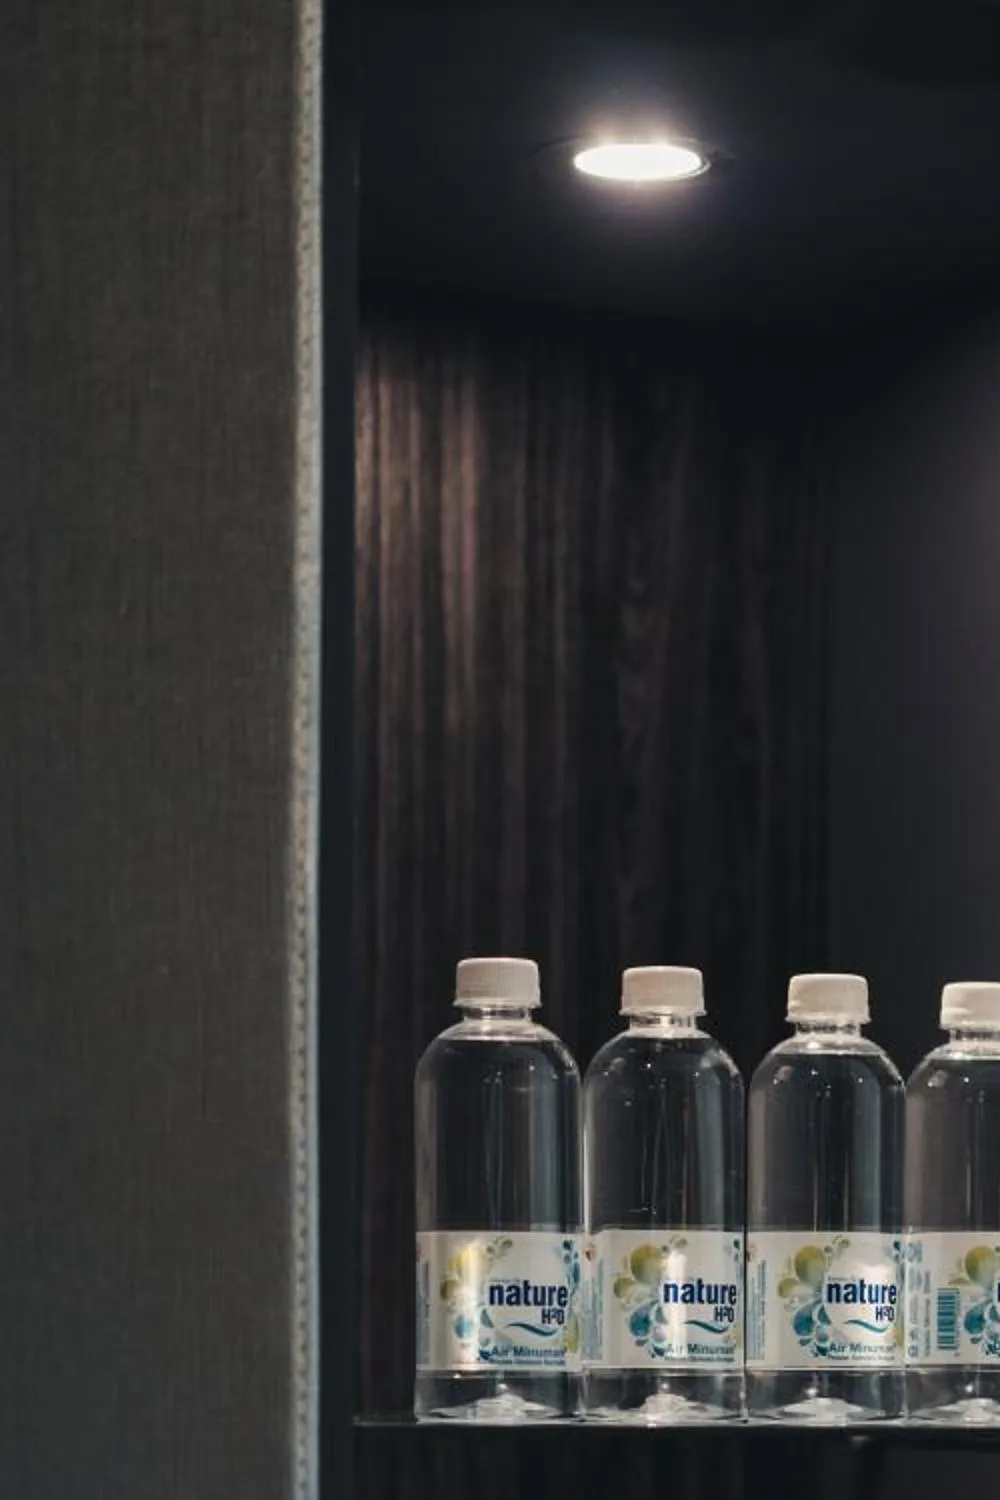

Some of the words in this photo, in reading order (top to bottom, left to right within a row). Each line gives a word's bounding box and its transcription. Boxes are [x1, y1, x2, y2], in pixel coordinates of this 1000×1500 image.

[489, 1280, 569, 1307] nature
[663, 1278, 737, 1305] nature
[827, 1280, 897, 1305] nature
